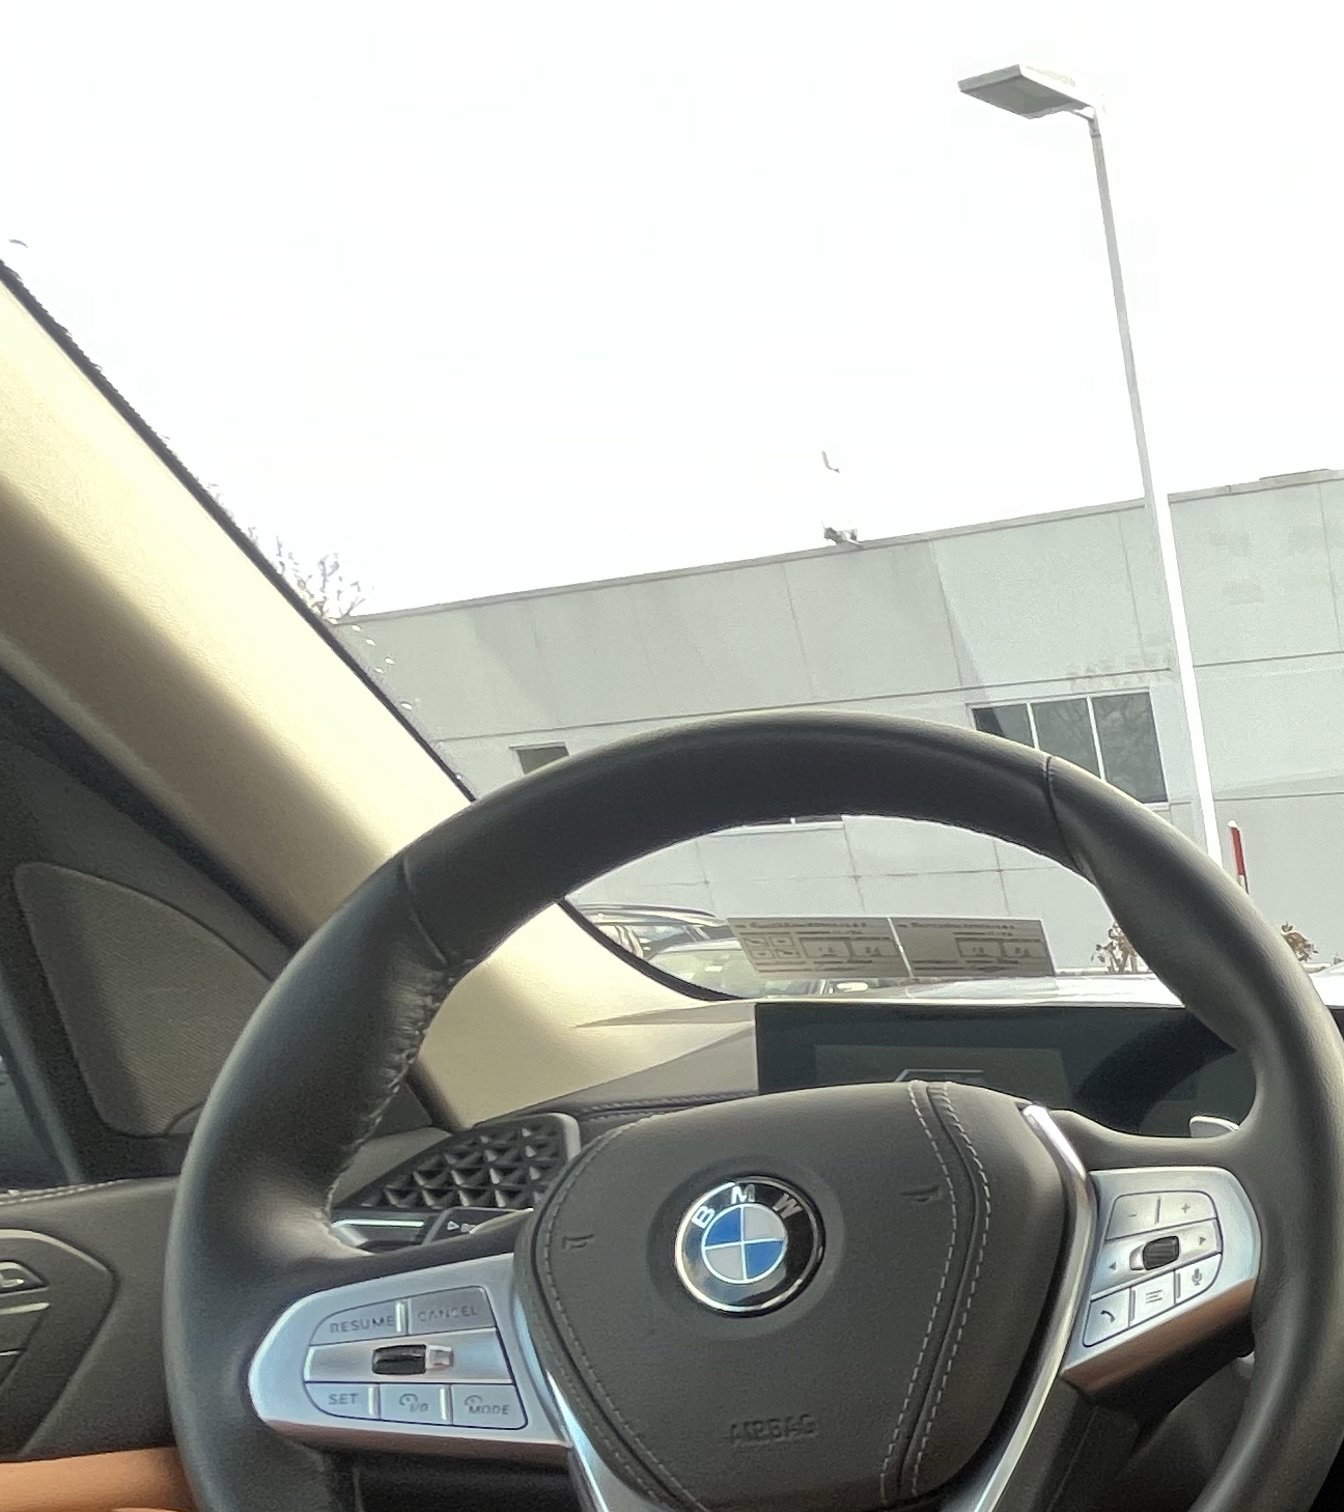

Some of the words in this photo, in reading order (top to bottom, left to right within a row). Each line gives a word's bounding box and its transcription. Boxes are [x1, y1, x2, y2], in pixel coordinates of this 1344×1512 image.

[691, 1183, 802, 1229] BMW
[417, 1304, 479, 1323] CANCEL
[329, 1315, 395, 1334] RESUME
[328, 1392, 359, 1406] SET
[468, 1403, 511, 1416] MODE
